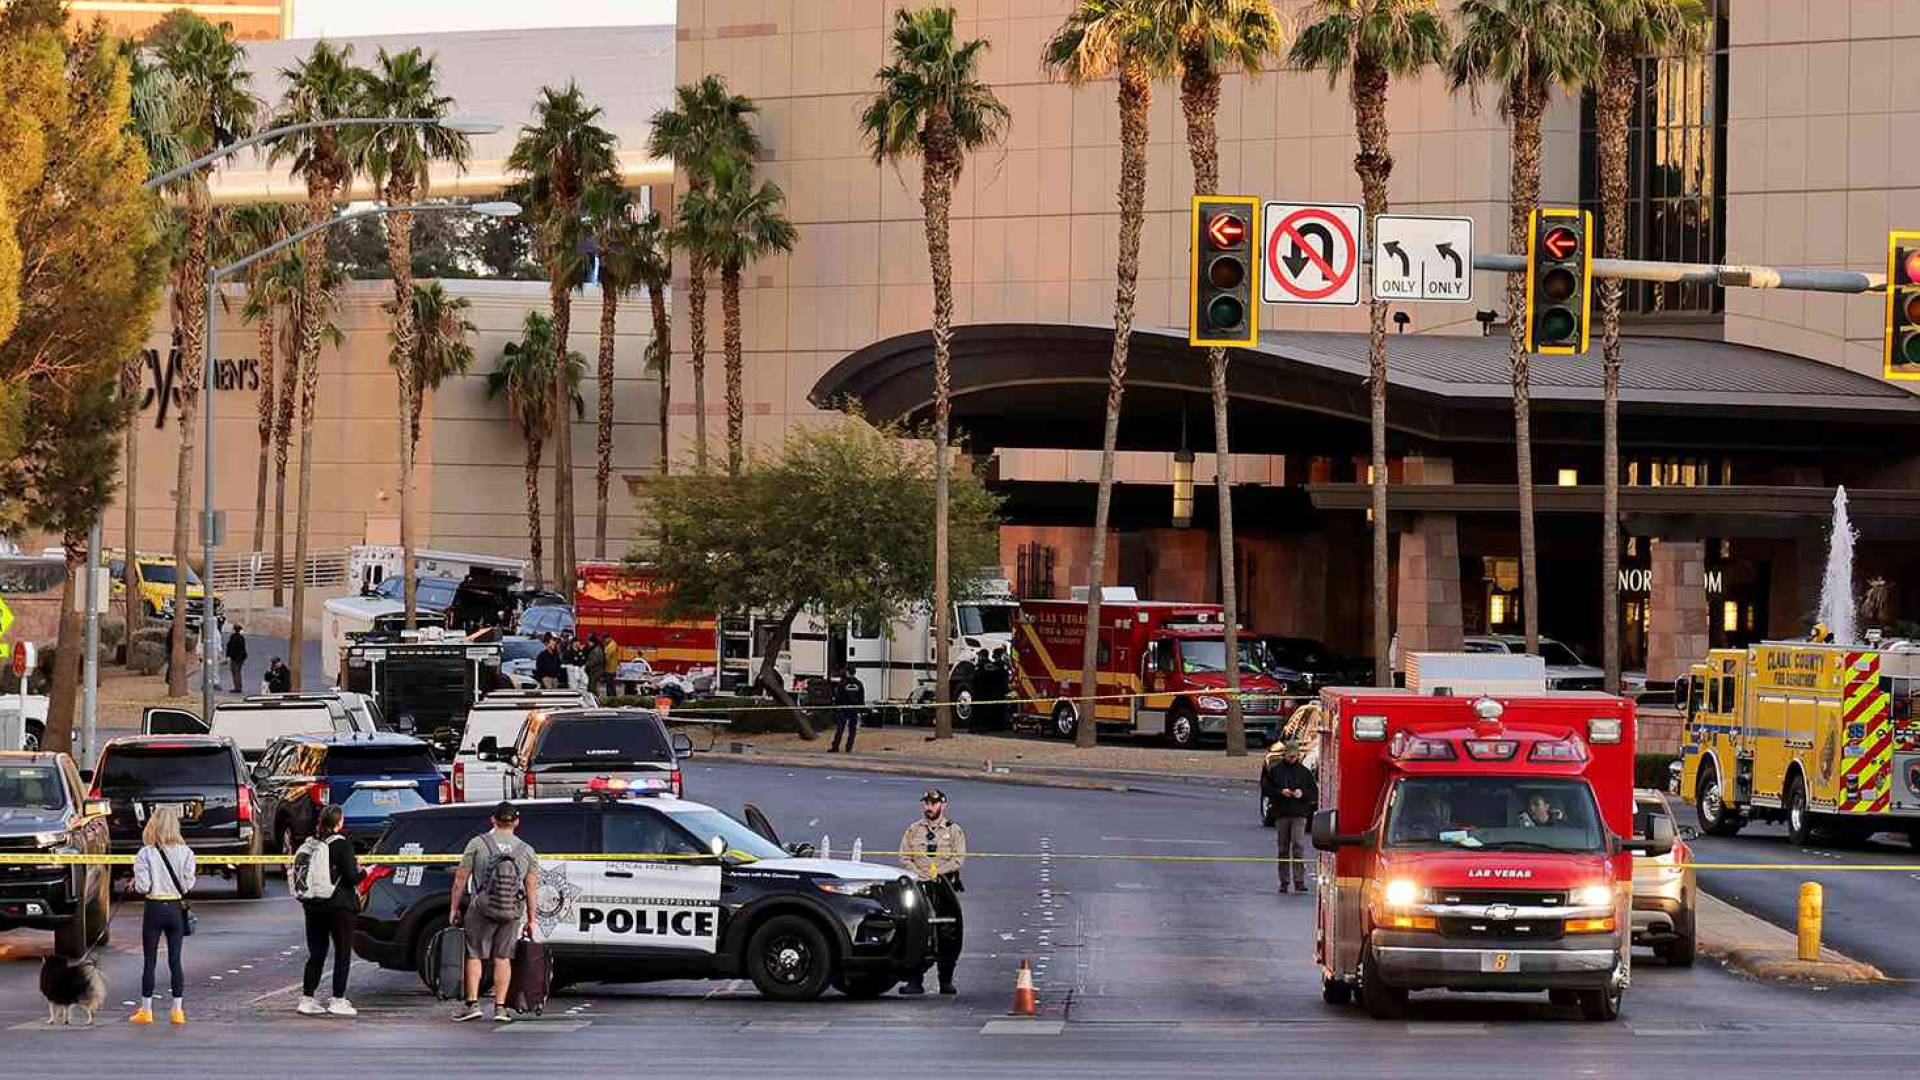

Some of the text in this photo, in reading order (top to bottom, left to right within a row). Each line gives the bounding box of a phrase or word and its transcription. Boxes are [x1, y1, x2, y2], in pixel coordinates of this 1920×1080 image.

[1382, 280, 1415, 293] ONLY
[1429, 281, 1462, 294] ONLY
[1061, 614, 1088, 625] VEGA
[1794, 652, 1824, 673] COUNTY
[1468, 869, 1532, 878] LAS VEGAS
[578, 907, 714, 937] POLICE
[1495, 953, 1507, 970] 8
